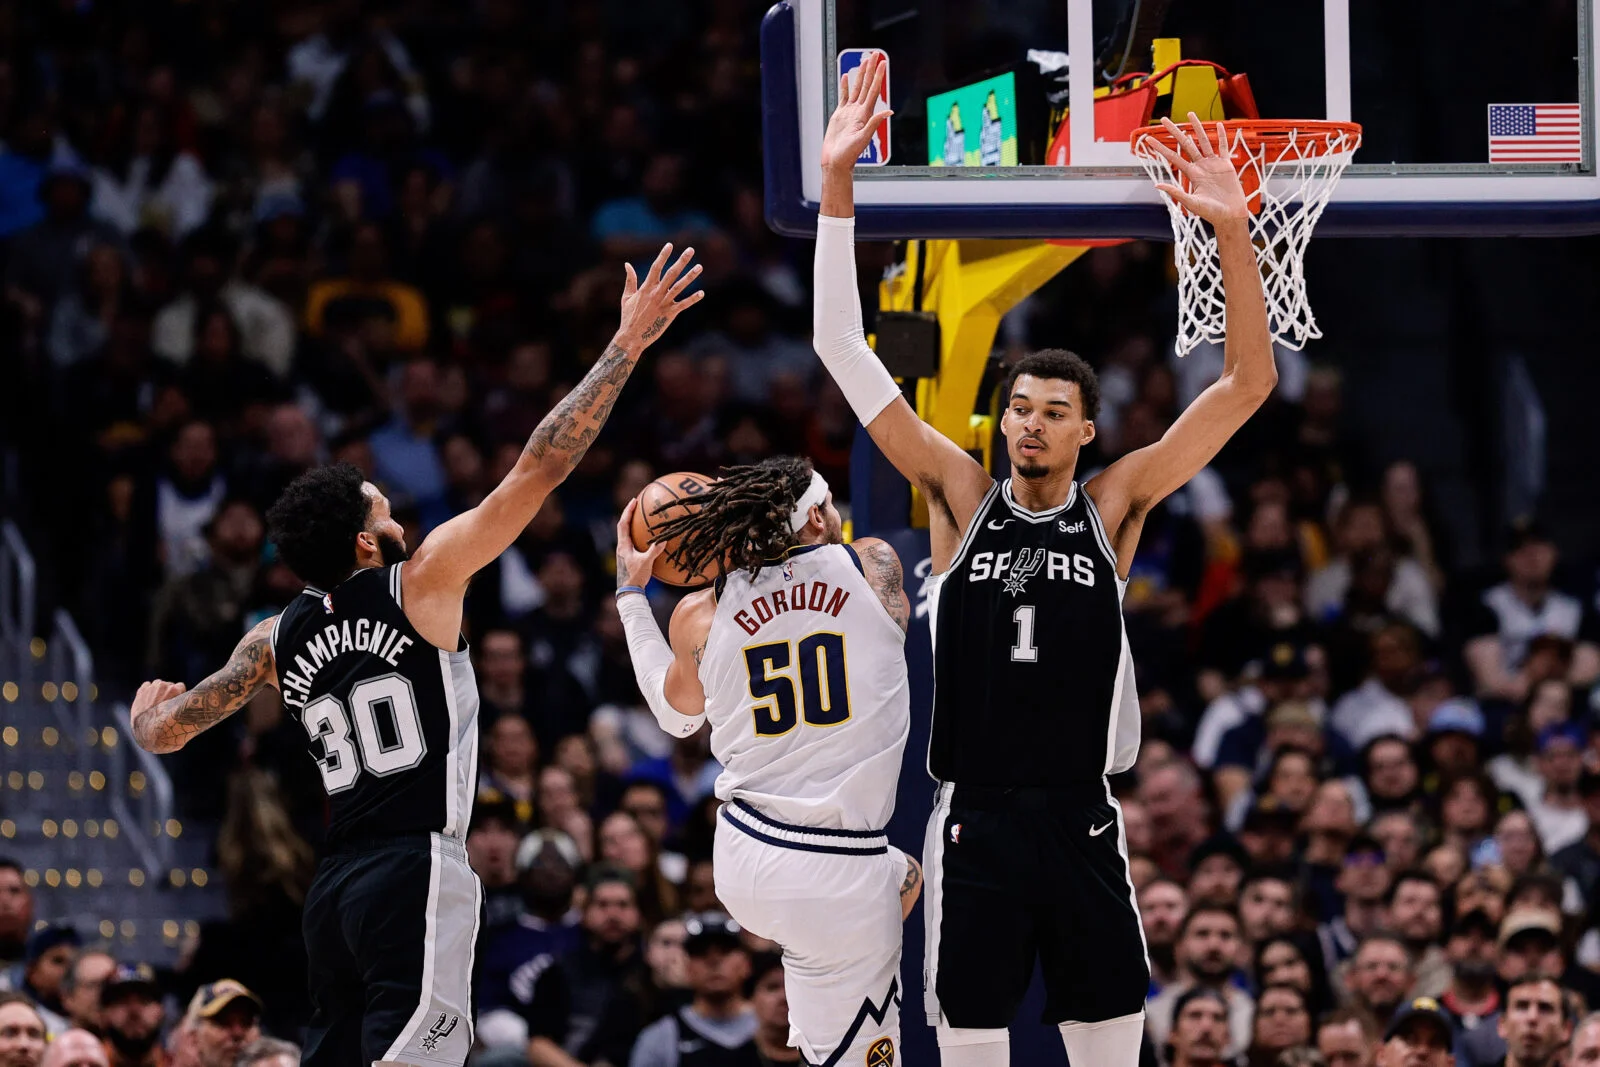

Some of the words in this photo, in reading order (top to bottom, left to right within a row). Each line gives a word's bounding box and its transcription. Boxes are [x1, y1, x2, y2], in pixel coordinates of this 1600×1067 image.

[1058, 520, 1087, 533] Self.
[969, 548, 1095, 597] SPURS
[733, 581, 850, 636] GORDON
[1011, 605, 1038, 662] 1
[283, 618, 413, 708] CHAMPAGNIE
[741, 630, 852, 738] 50
[301, 671, 428, 796] 30
